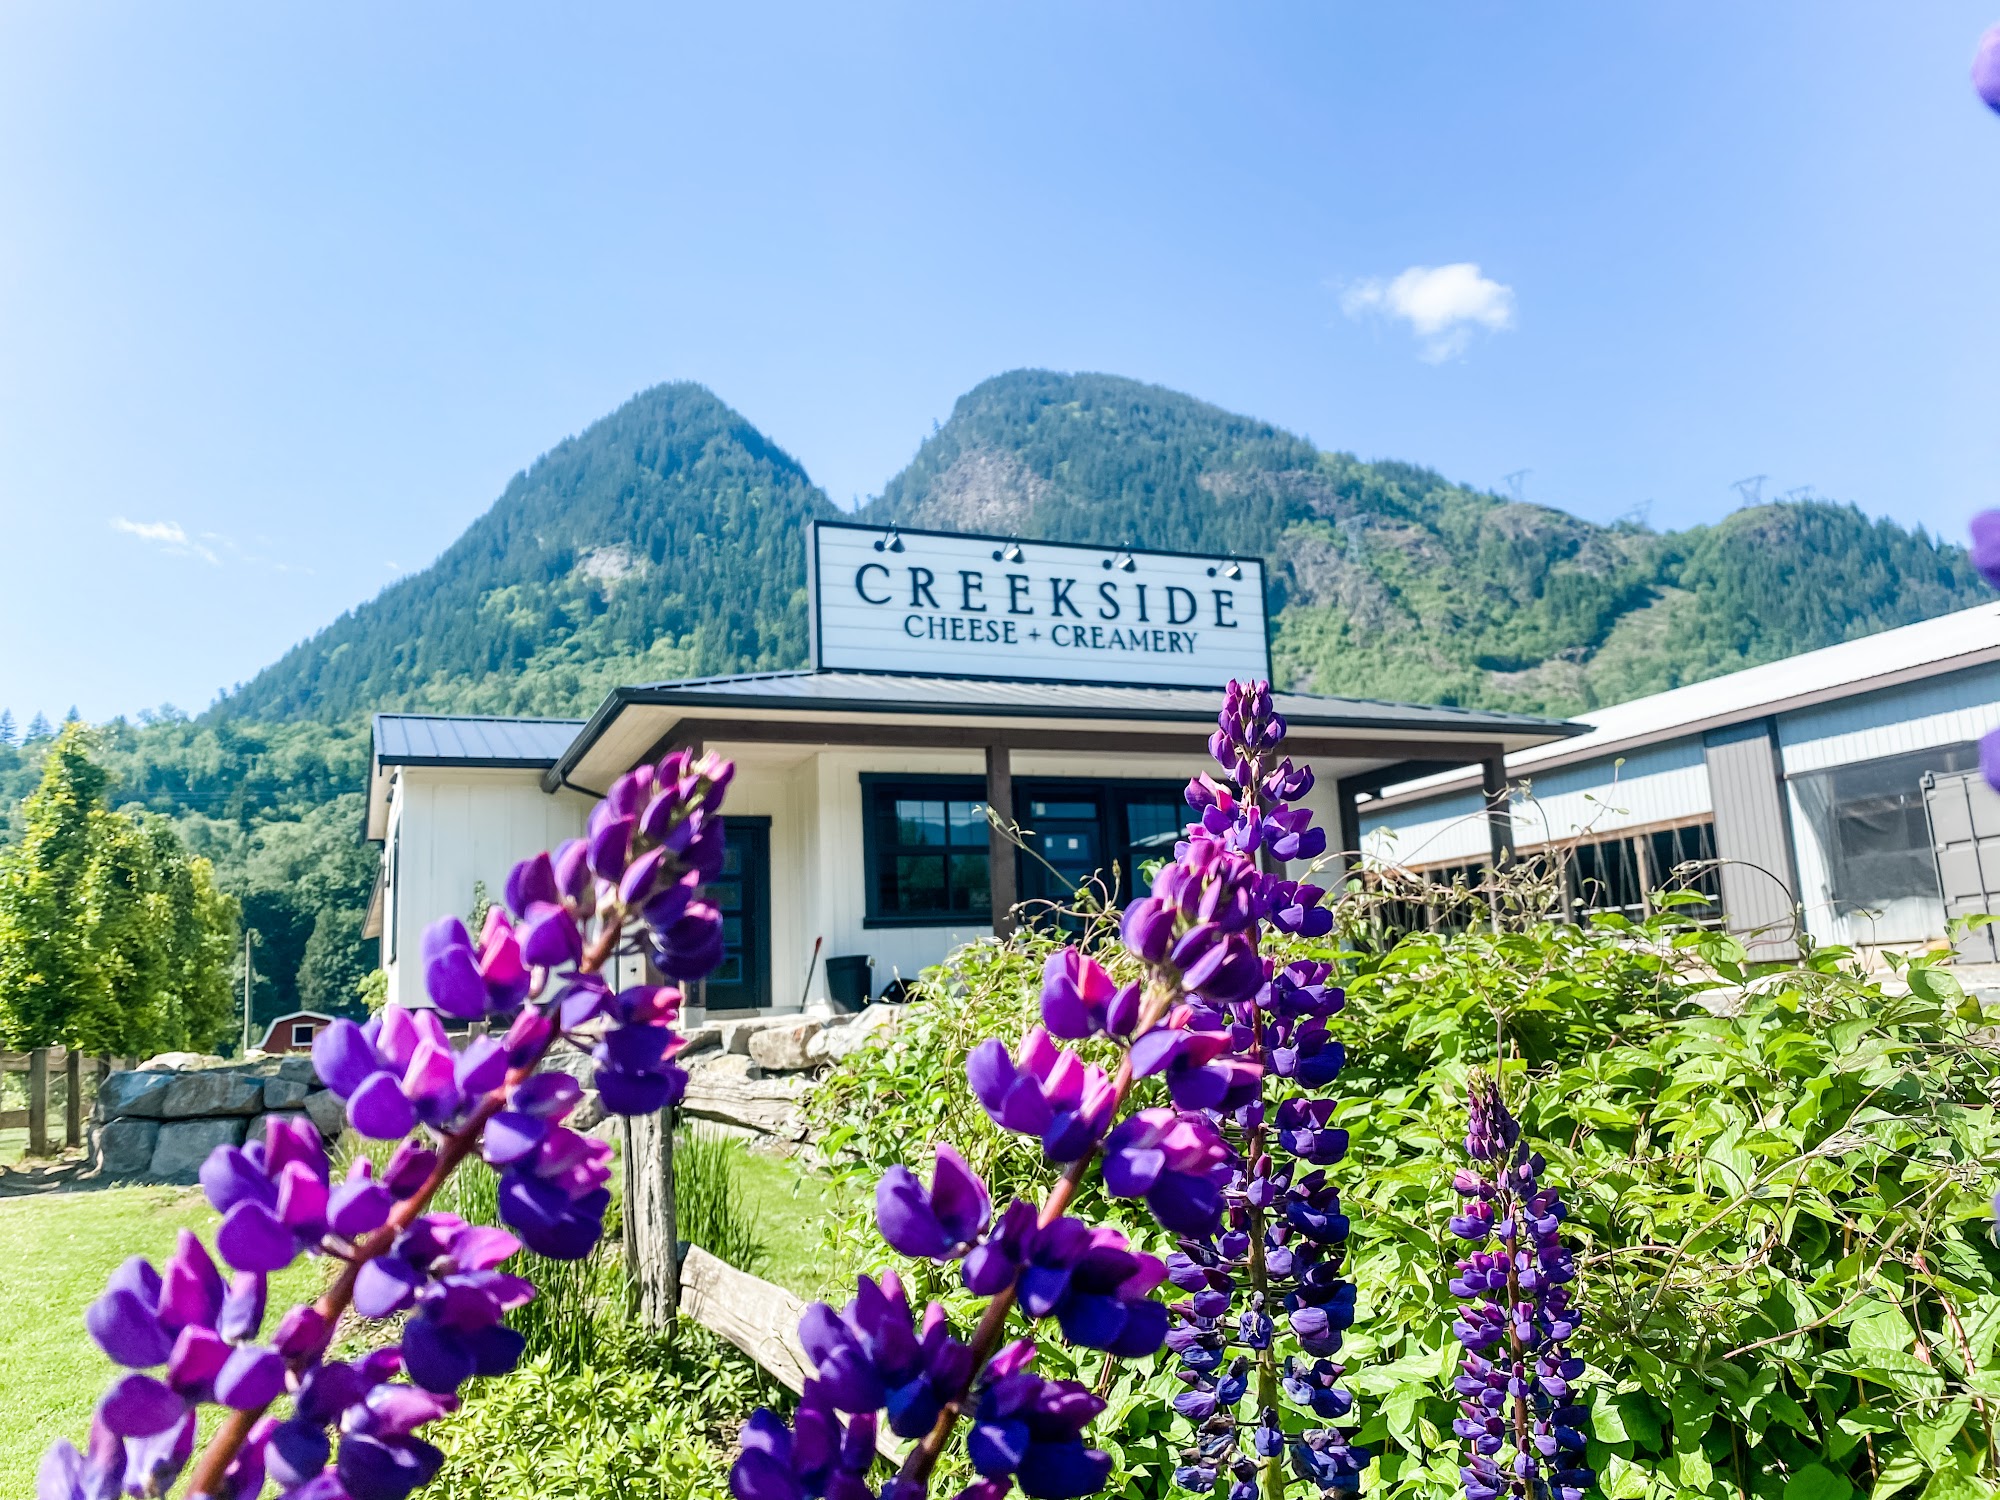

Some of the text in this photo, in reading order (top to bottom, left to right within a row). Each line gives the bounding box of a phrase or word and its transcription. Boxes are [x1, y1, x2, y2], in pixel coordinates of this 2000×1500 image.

[854, 562, 1238, 629] CREEKSIDE
[903, 614, 1199, 655] CHEESE + CREAMERY
